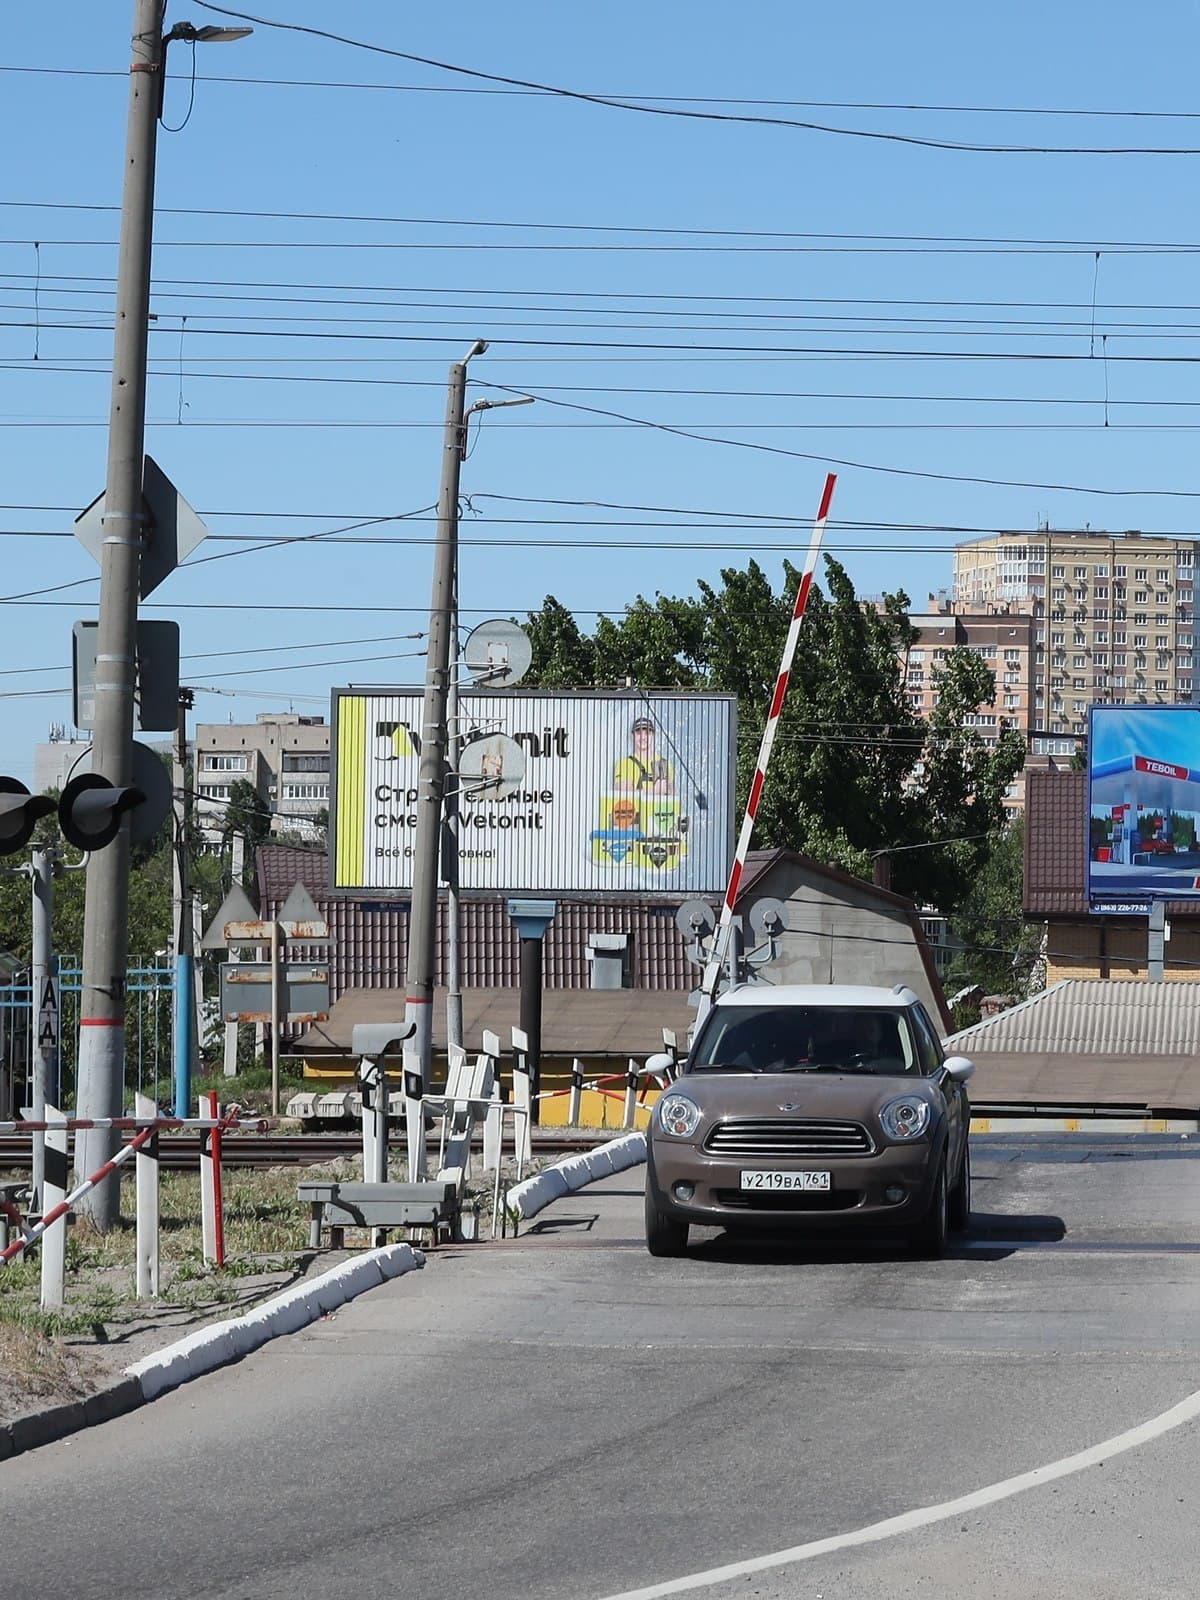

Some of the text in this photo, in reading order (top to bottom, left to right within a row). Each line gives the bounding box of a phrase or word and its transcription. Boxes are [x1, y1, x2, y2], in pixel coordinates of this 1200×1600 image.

[1145, 760, 1177, 776] TEBOIL
[458, 810, 543, 829] Vetonit
[746, 1173, 827, 1188] У219ВА 761
